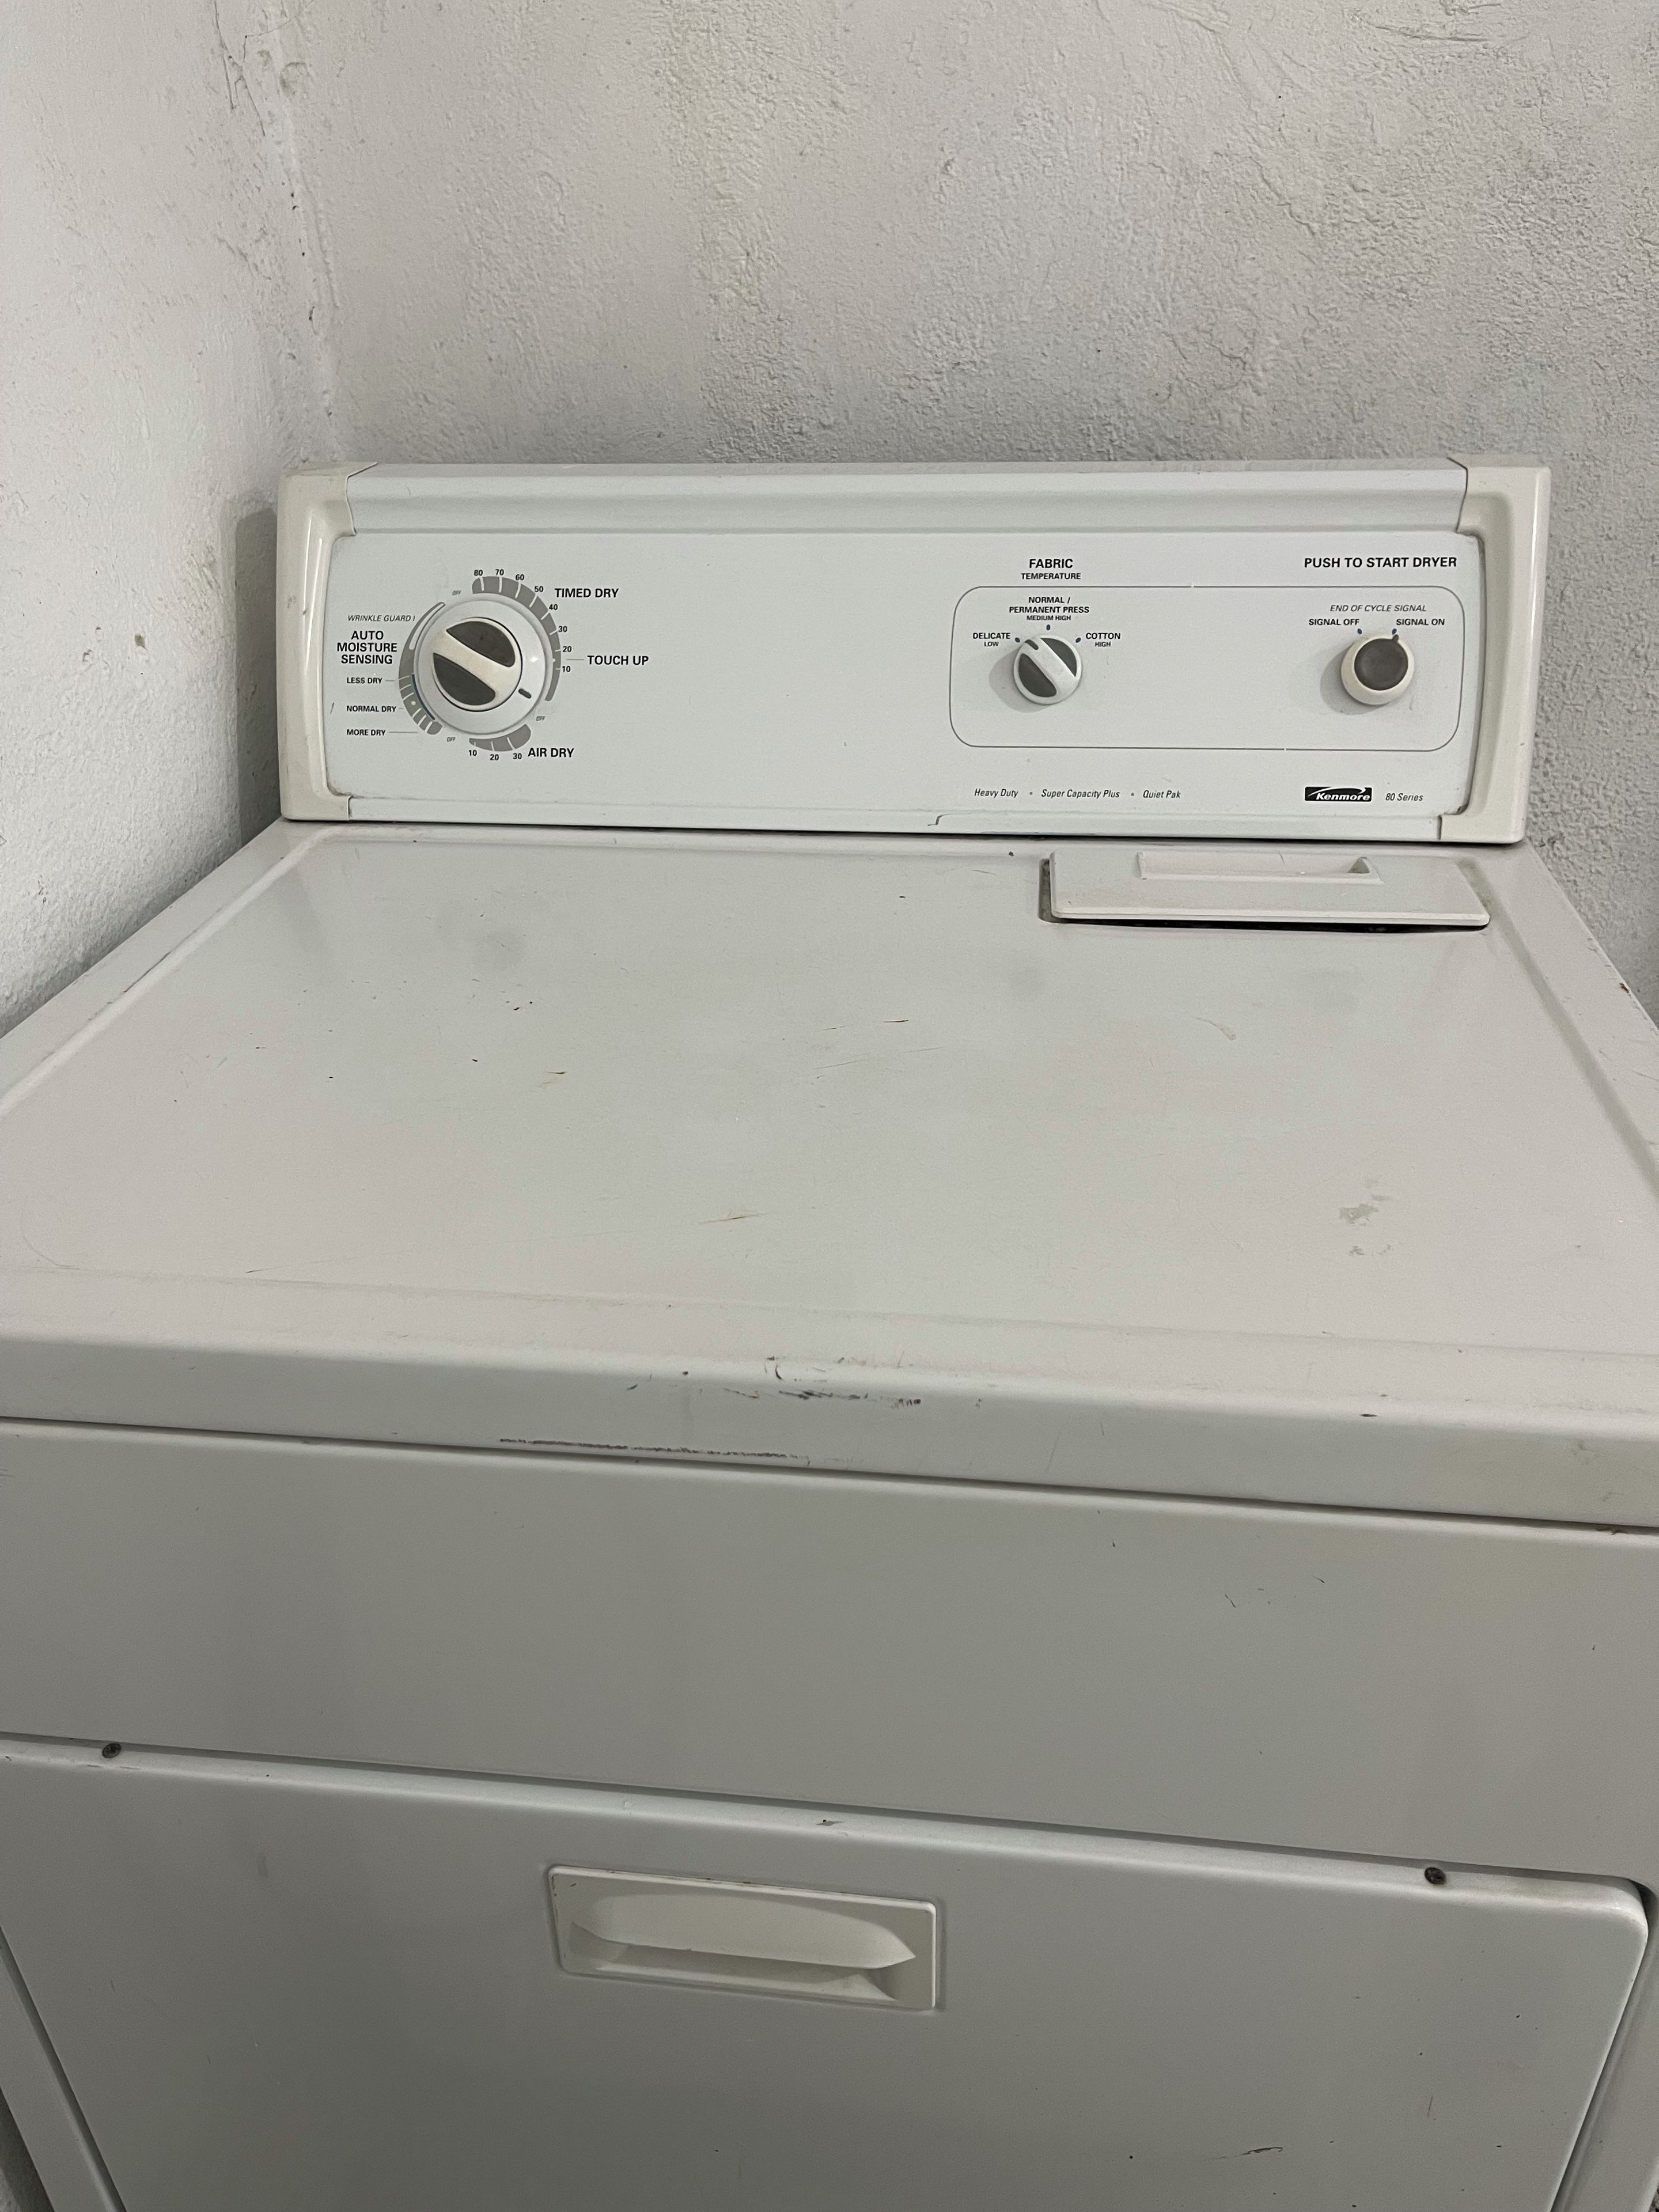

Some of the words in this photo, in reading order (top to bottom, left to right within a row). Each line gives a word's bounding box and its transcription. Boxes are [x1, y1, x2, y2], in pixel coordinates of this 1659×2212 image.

[1029, 558, 1073, 569] FABRIC
[1304, 557, 1340, 568] PUSH
[1344, 557, 1363, 568] TO
[1366, 557, 1410, 568] START
[1412, 556, 1457, 567] DRYER
[514, 574, 525, 583] 60
[533, 585, 544, 594] 50
[554, 588, 592, 598] TIMED
[594, 588, 619, 598] DRY
[1067, 596, 1071, 604] /
[547, 603, 558, 612] 40
[1330, 604, 1349, 612] END
[1350, 604, 1363, 612] OF
[1364, 604, 1392, 612] CYCLE
[1393, 604, 1427, 612] SIGNAL
[1396, 618, 1429, 626] SIGNAL
[1431, 618, 1445, 626] ON
[556, 626, 568, 634] 30
[351, 630, 384, 641] AUTO
[1085, 632, 1121, 640] COTTON
[337, 642, 397, 653] MOISTURE
[340, 654, 393, 665] SENSING
[586, 655, 629, 665] TOUCH
[632, 656, 649, 665] UP
[527, 747, 547, 757] AIR
[550, 748, 574, 758] DRY
[974, 788, 999, 798] Heavy
[1000, 788, 1019, 798] Duty
[1041, 789, 1066, 799] Super
[1066, 789, 1102, 800] Capacity
[1103, 789, 1120, 798] Plus
[1143, 789, 1164, 798] Quiet
[1165, 790, 1181, 798] Pak
[1315, 791, 1370, 802] Kenmore
[1385, 793, 1396, 801] 80
[1396, 793, 1424, 801] Series
